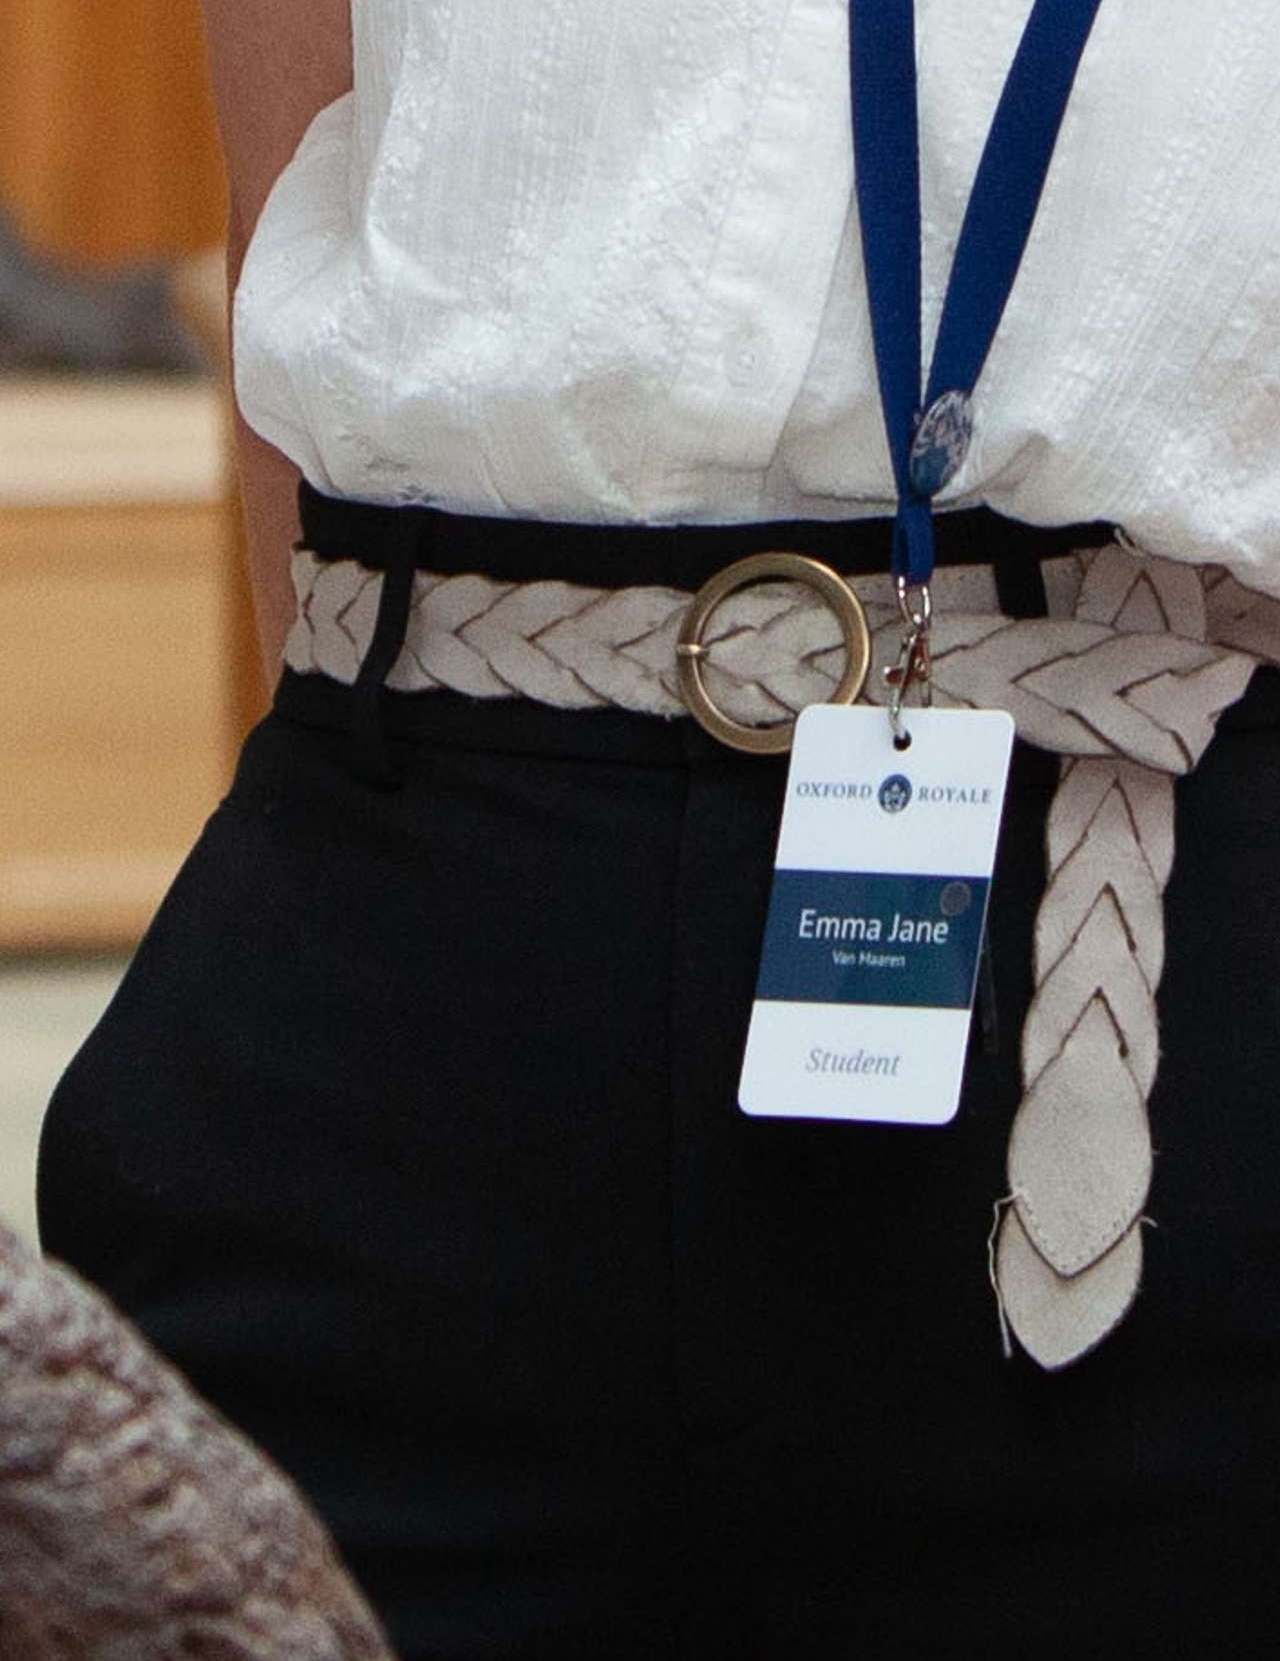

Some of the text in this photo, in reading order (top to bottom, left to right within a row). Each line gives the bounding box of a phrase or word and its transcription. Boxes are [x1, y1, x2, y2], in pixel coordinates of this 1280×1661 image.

[796, 782, 992, 804] OXFORD ROYALE
[798, 907, 950, 944] Emma Jane
[832, 949, 907, 968] Van Maaren
[805, 1047, 901, 1077] Student
